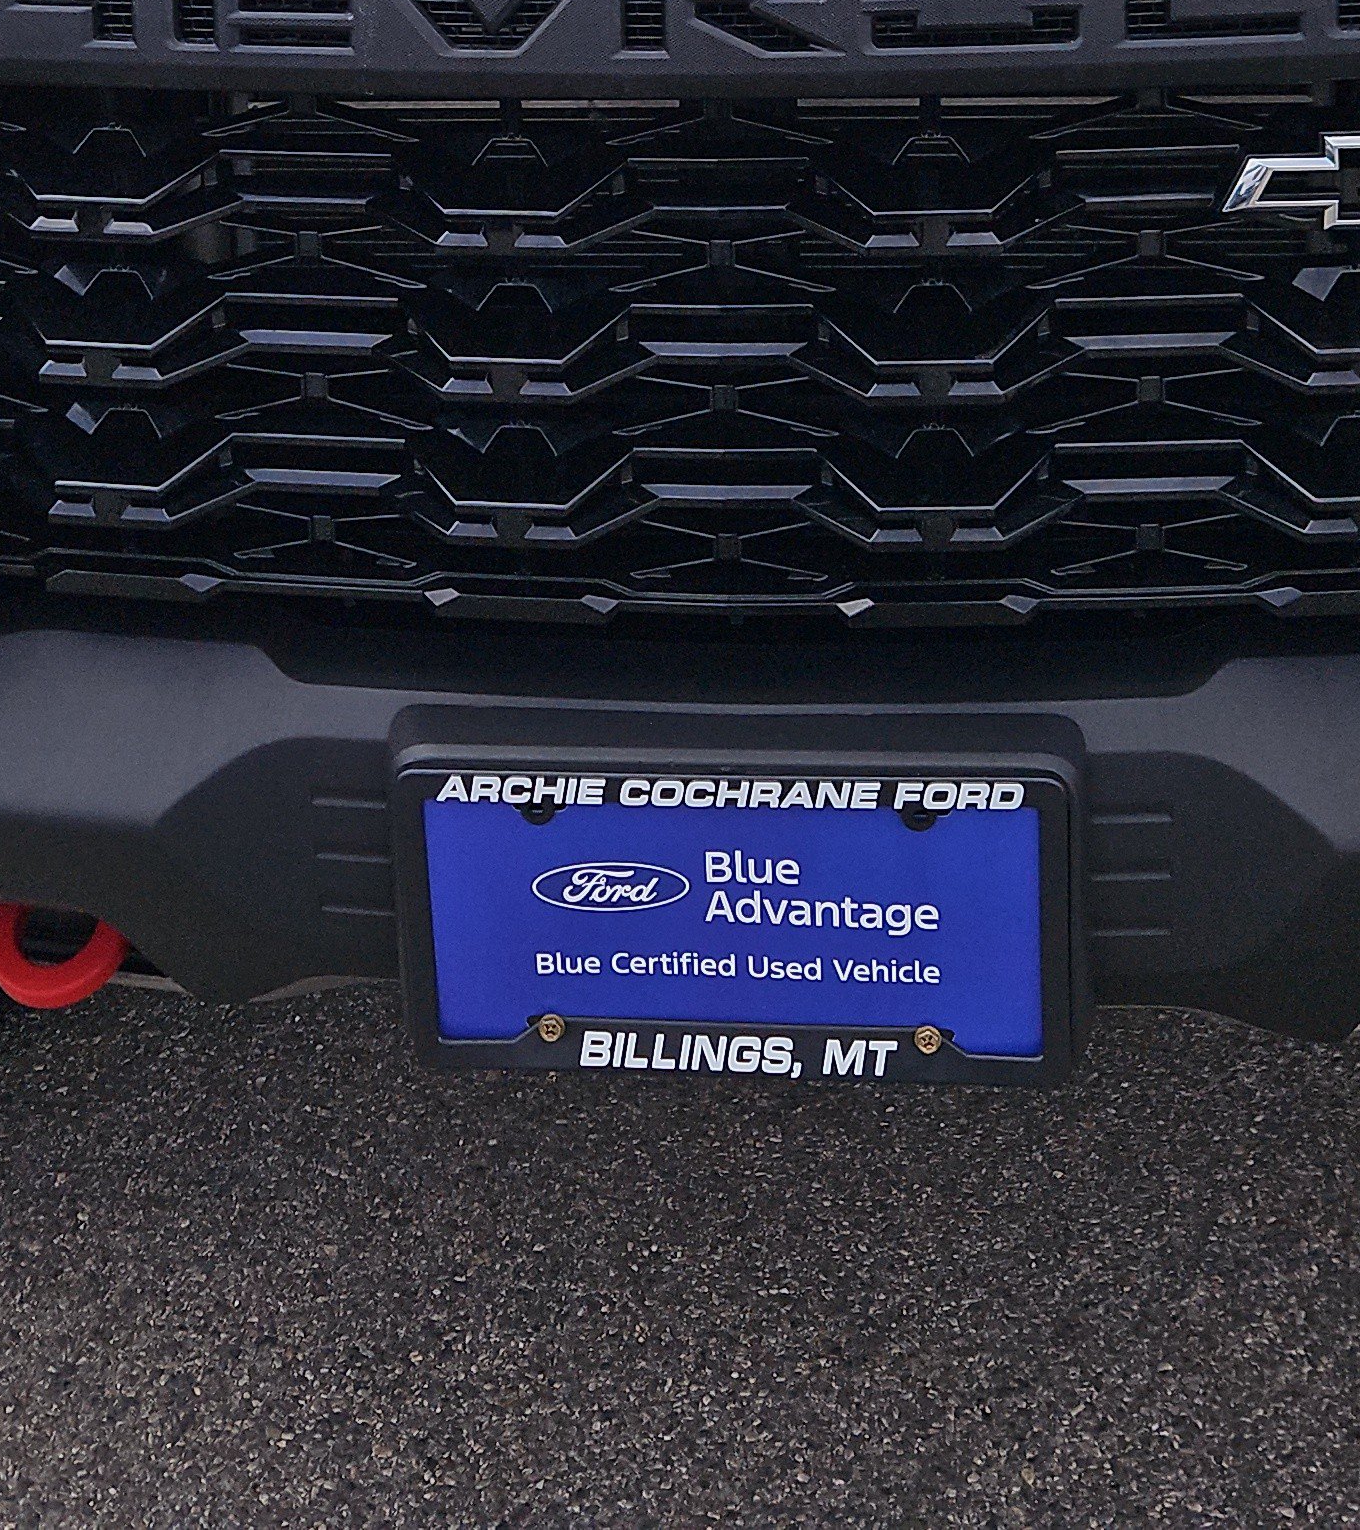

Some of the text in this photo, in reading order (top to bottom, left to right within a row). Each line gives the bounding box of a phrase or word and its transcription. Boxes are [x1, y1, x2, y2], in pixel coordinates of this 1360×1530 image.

[436, 774, 1025, 810] ARCHIE COCHRANE FORD
[704, 849, 801, 885] Blue
[562, 868, 660, 903] Ford
[704, 889, 940, 936] Advantage
[535, 951, 941, 984] Blue Certified Used Vehicle
[578, 1030, 899, 1079] BILLINGS, MT
